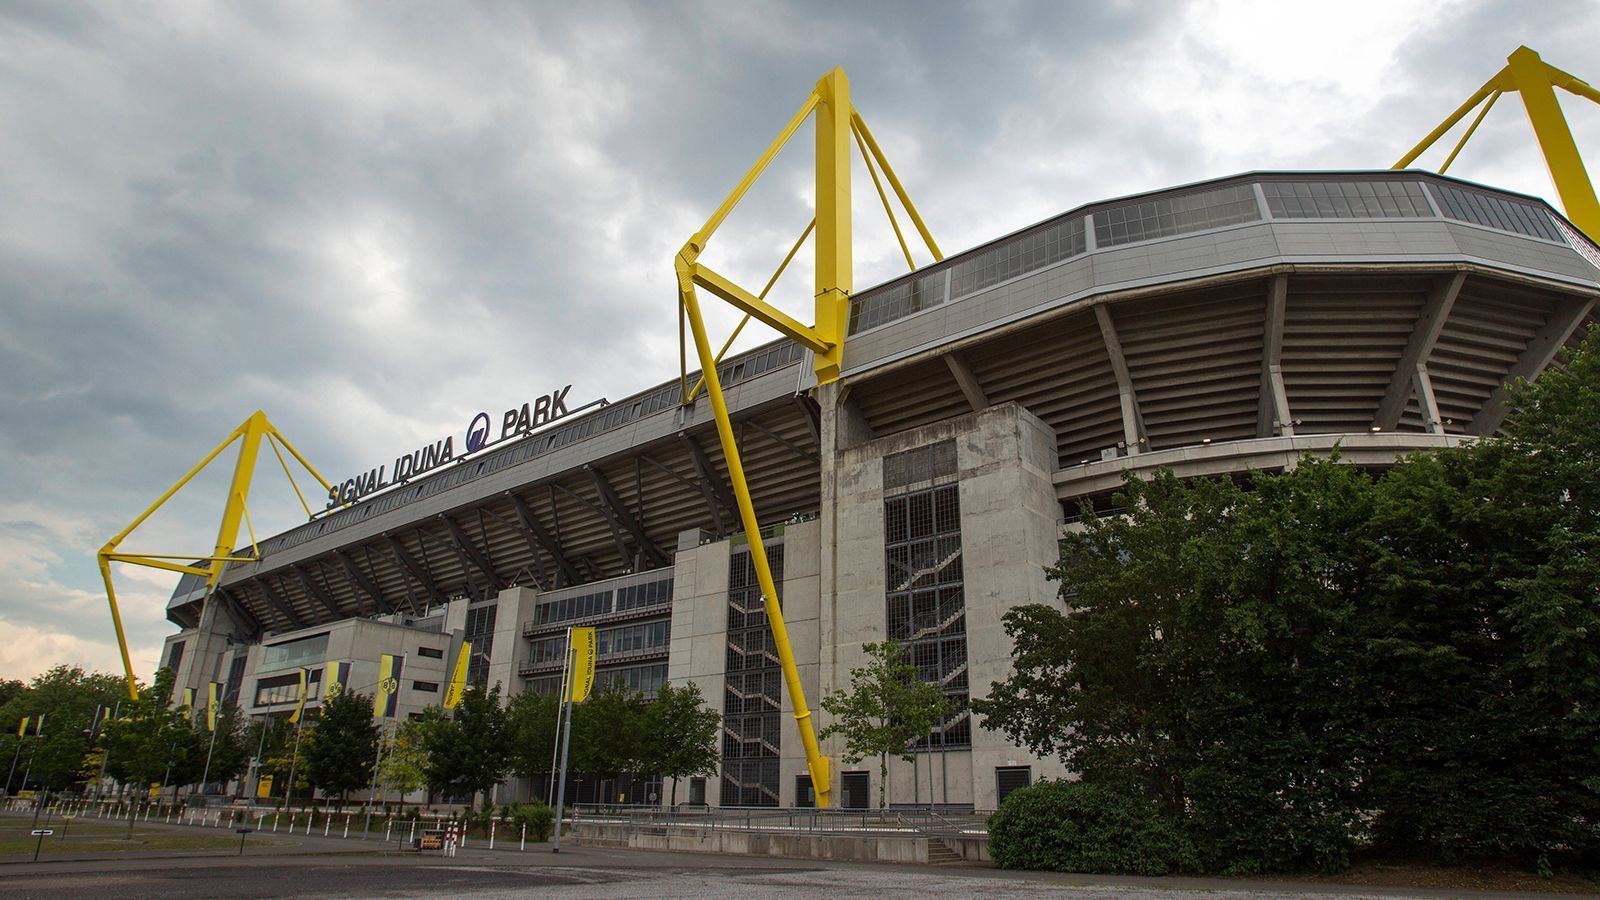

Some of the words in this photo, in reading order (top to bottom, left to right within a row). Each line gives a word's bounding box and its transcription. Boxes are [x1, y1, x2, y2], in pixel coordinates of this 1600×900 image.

[326, 465, 388, 511] SIGNAL
[392, 436, 455, 482] IDUNA
[501, 384, 572, 440] PARK
